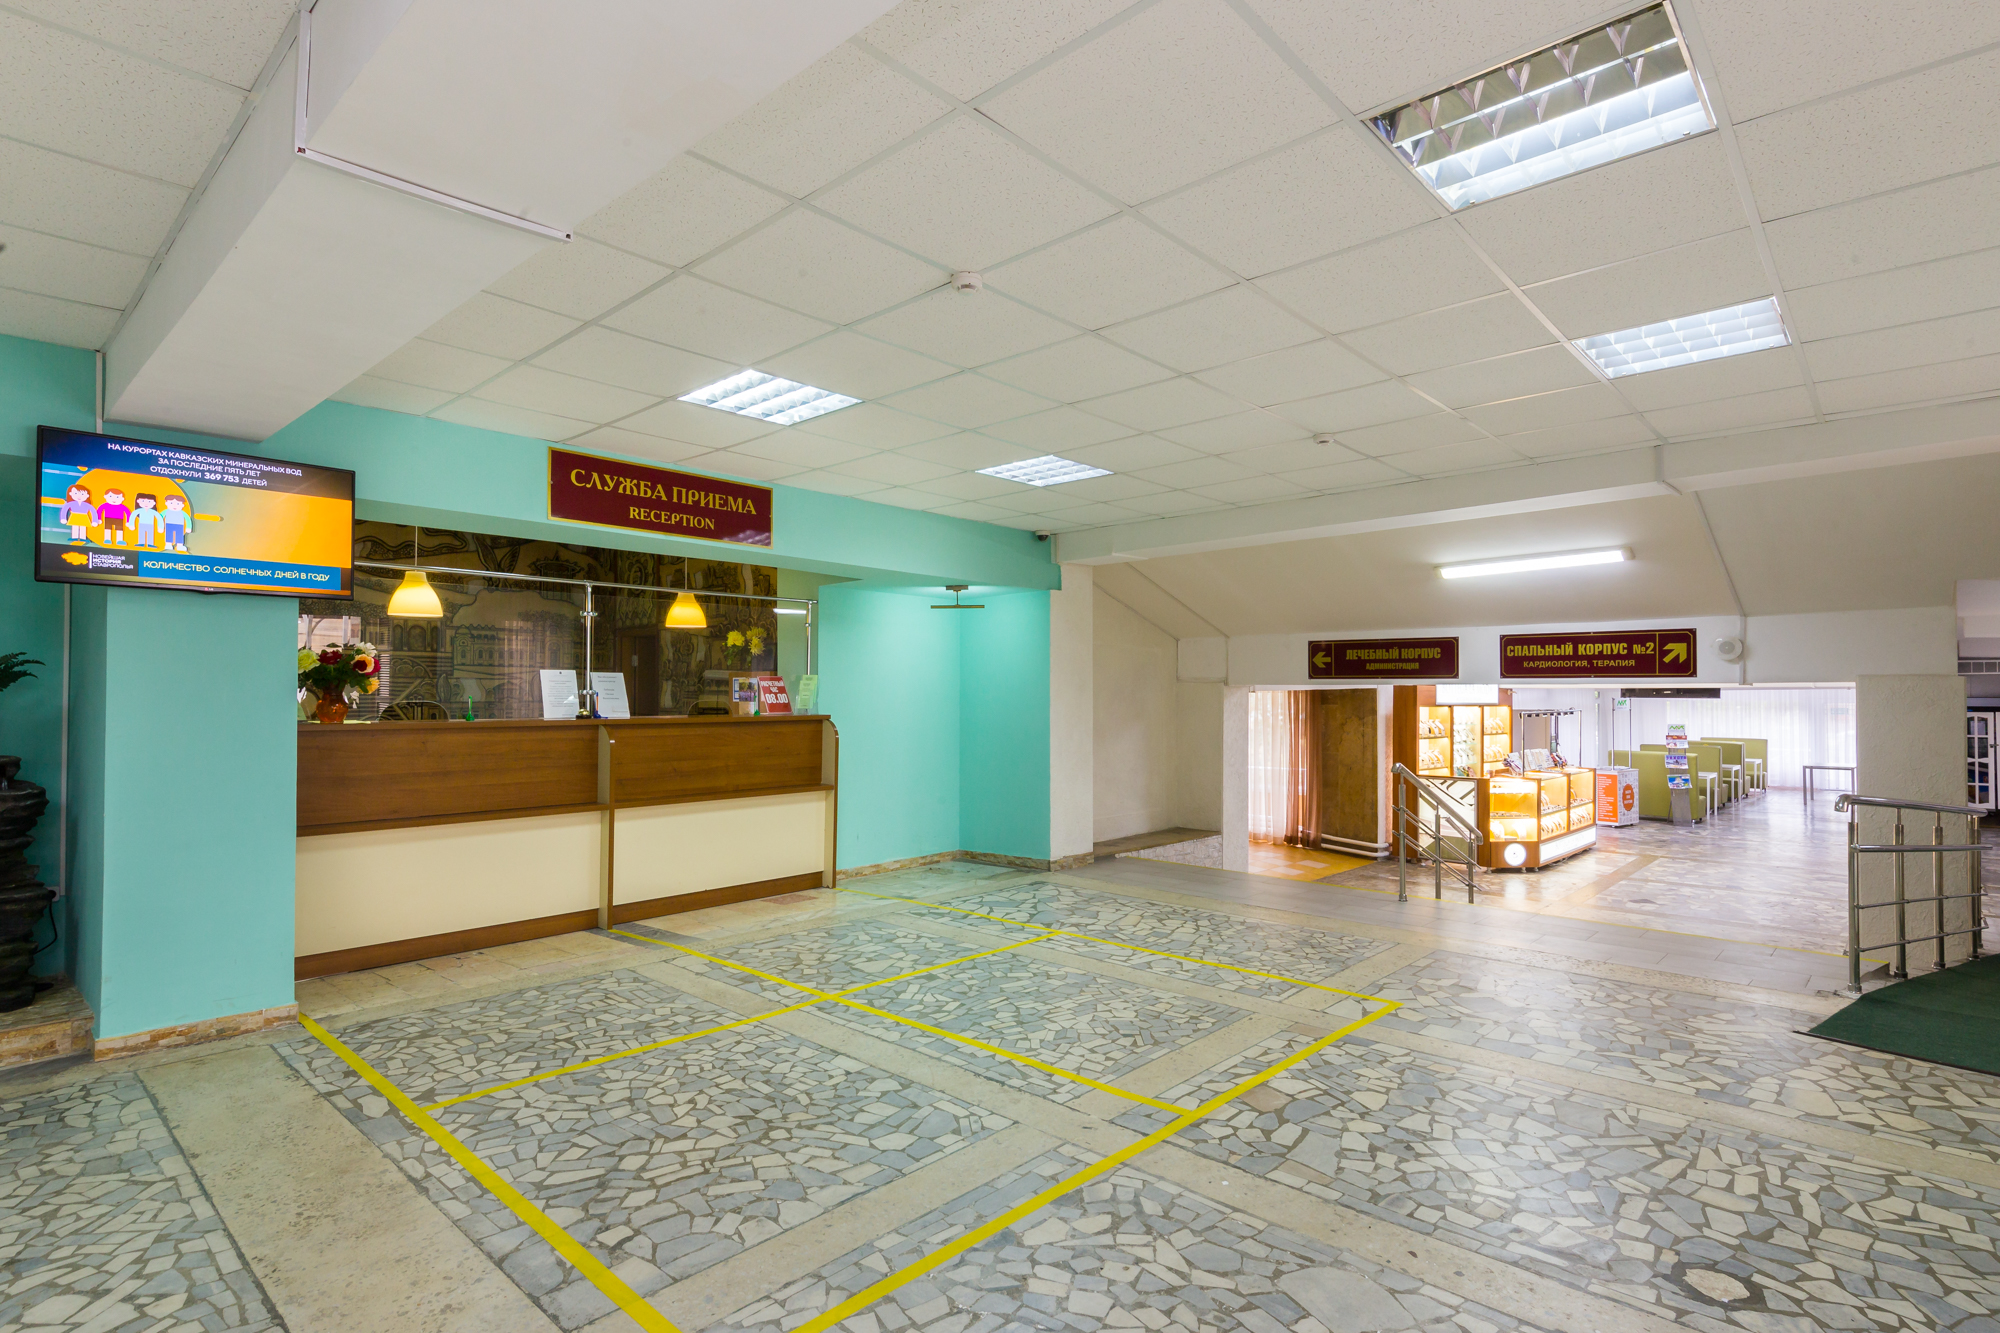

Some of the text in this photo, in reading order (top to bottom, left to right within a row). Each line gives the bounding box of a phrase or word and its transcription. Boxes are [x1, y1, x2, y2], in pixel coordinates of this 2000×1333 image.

[107, 443, 302, 477] НА КУРОРТАХ КАВКАЗСКИХ МИНЕРАЛЬНЫХ ВОД
[158, 457, 170, 465] ЗА
[170, 459, 223, 472] ПОСЛЕДНИЕ
[224, 466, 245, 475] ПЯТЬ
[150, 465, 268, 487] ОТДОХНУЛИ 369 753 ДЕТЕЙ
[570, 468, 757, 515] СЛУЖБА ПРИЕМА
[629, 506, 715, 530] RECEPTION
[143, 560, 330, 582] КОЛИЧЕСТВО СОЛНЕЧНЫХ ДНЕЙ В ГОДУ
[1346, 646, 1442, 660] ЛЕЧЕБНЫЙ КОРПУС
[1506, 642, 1655, 657] СПАЛЬНЫЙ КОРПУС №2
[1365, 662, 1420, 670] АДМИНИСТРАЦИЯ
[1523, 659, 1635, 669] КАРДИОЛОГИЯ, ТЕРАПИЯ
[765, 693, 789, 704] 08.00
